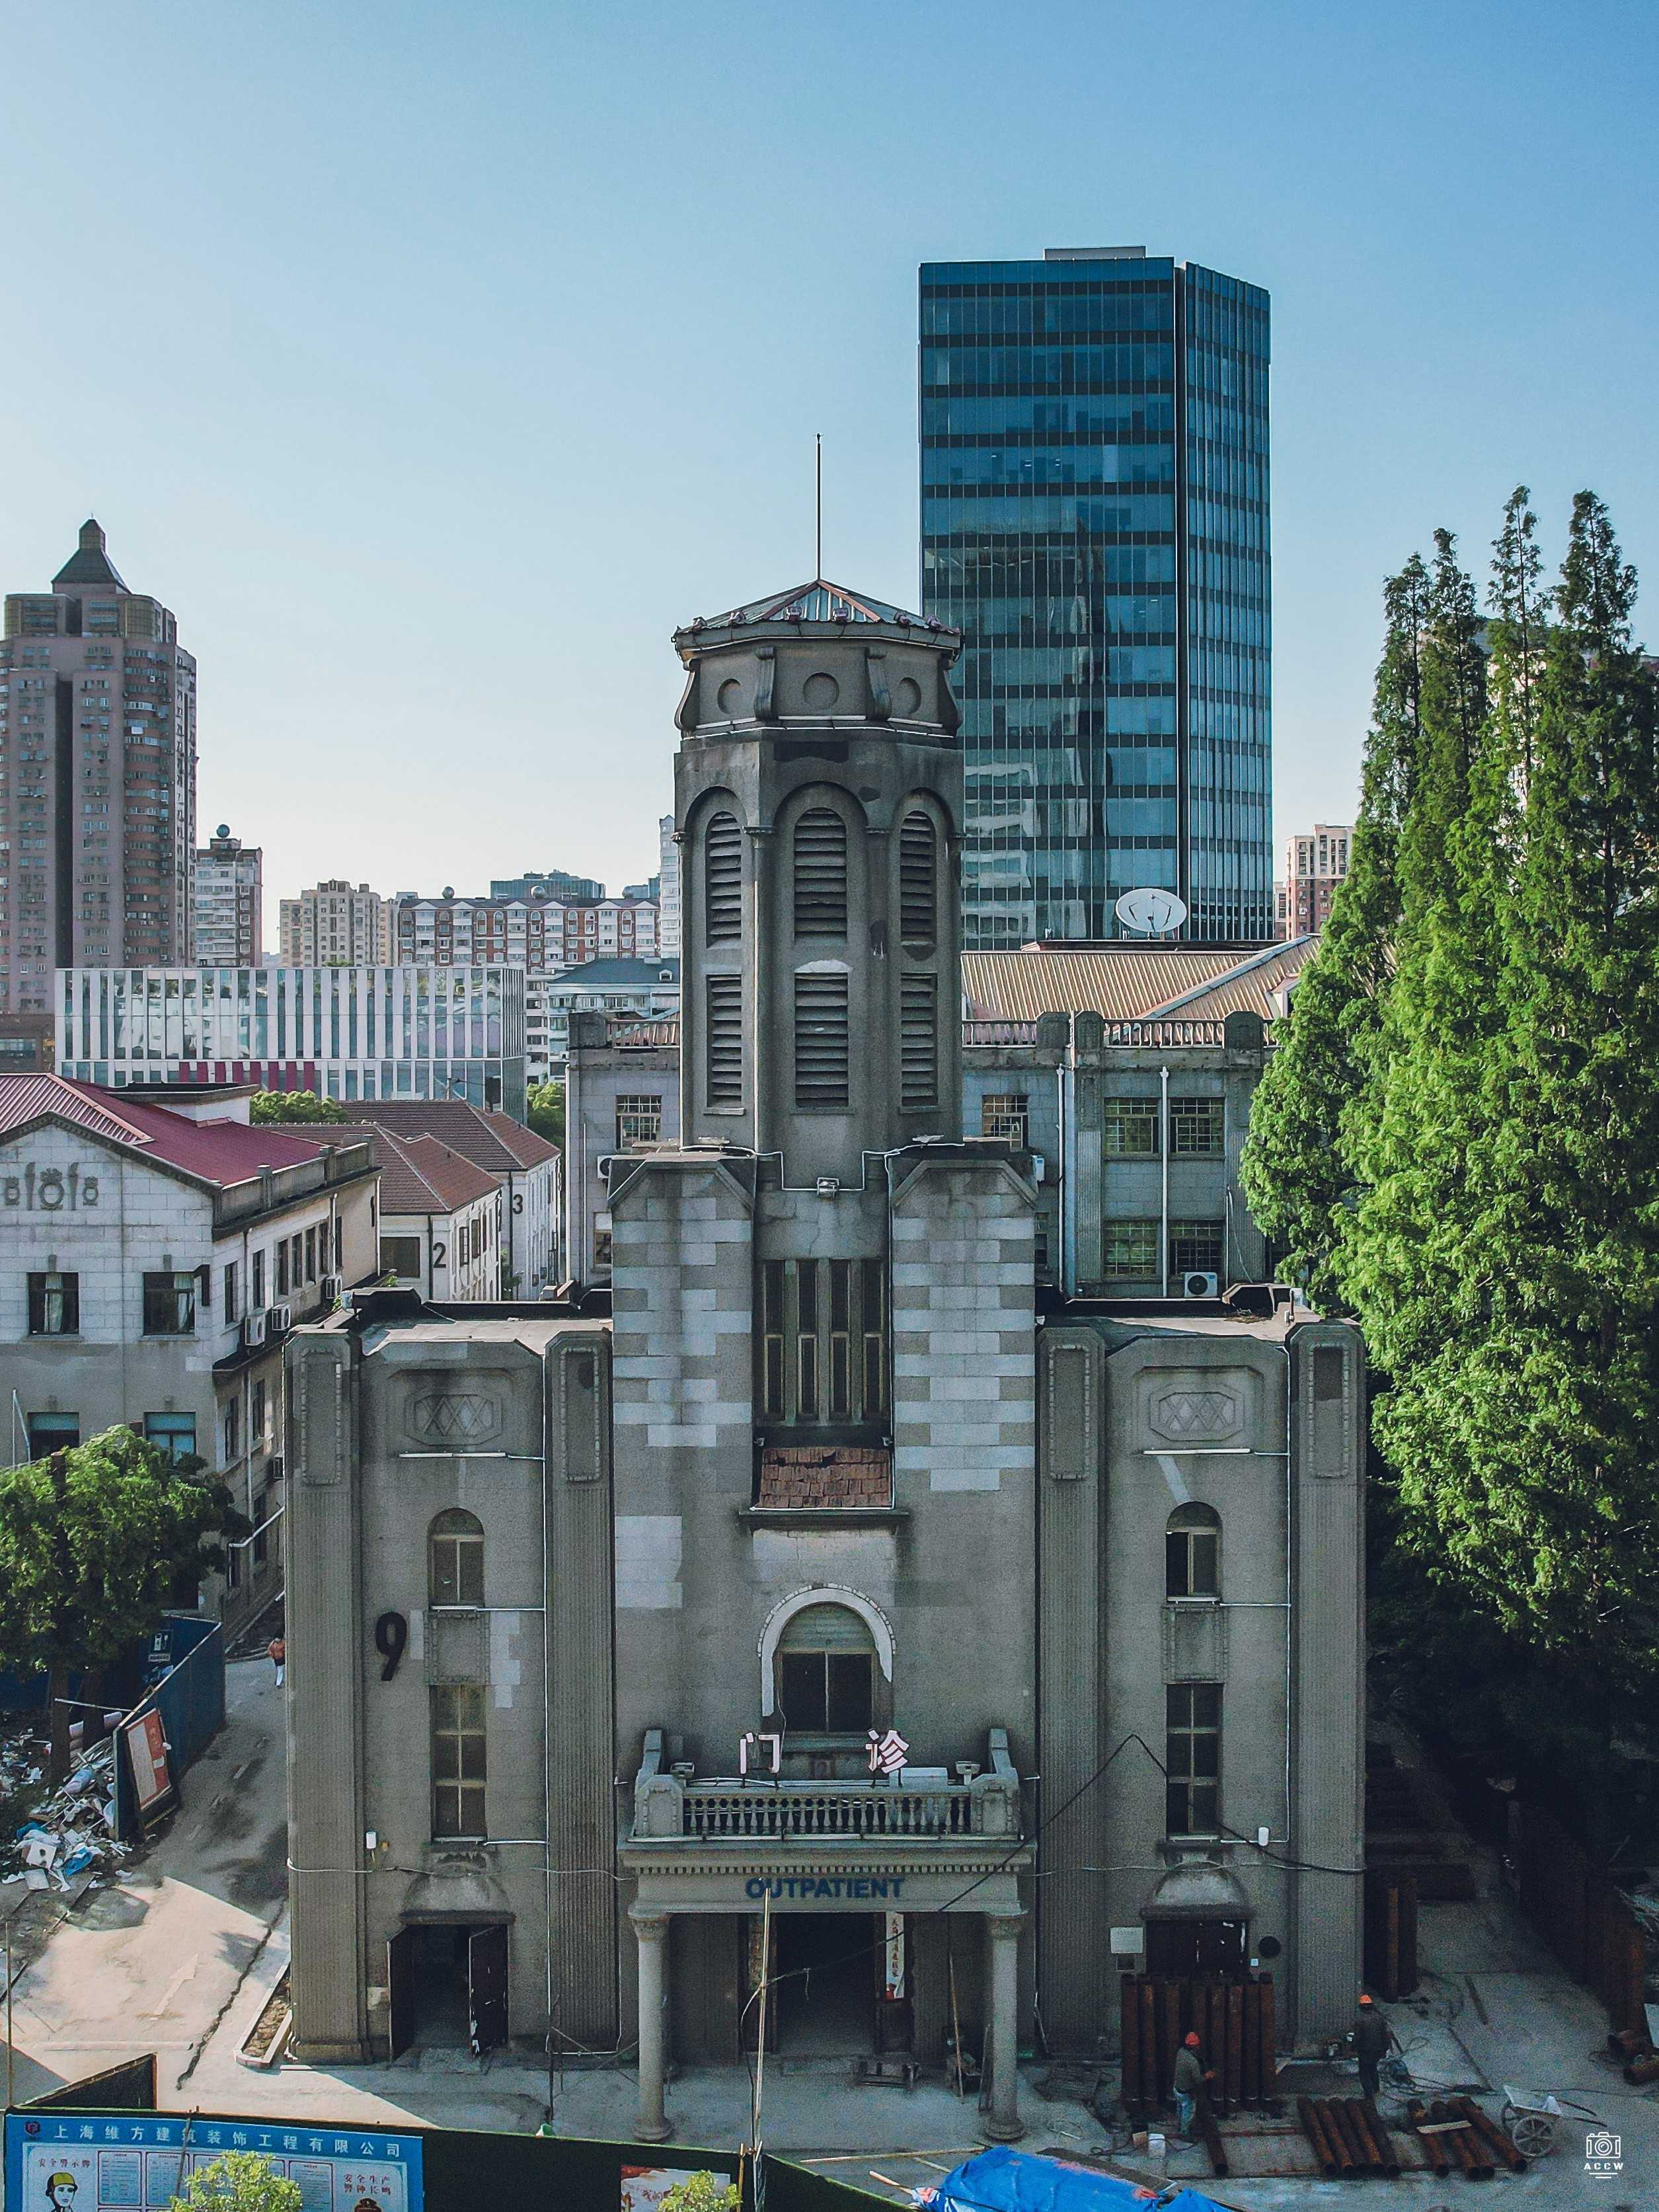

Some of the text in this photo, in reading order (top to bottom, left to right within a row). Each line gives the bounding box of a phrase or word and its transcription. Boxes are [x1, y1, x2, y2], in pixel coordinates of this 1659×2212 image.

[513, 1194, 523, 1215] 3
[433, 1242, 447, 1268] 2
[375, 1612, 407, 1681] 9
[739, 1729, 909, 1774] 门诊
[746, 1877, 905, 1899] OUTPATIENT
[54, 2123, 401, 2158] 上海维方建筑装饰工程有限公司
